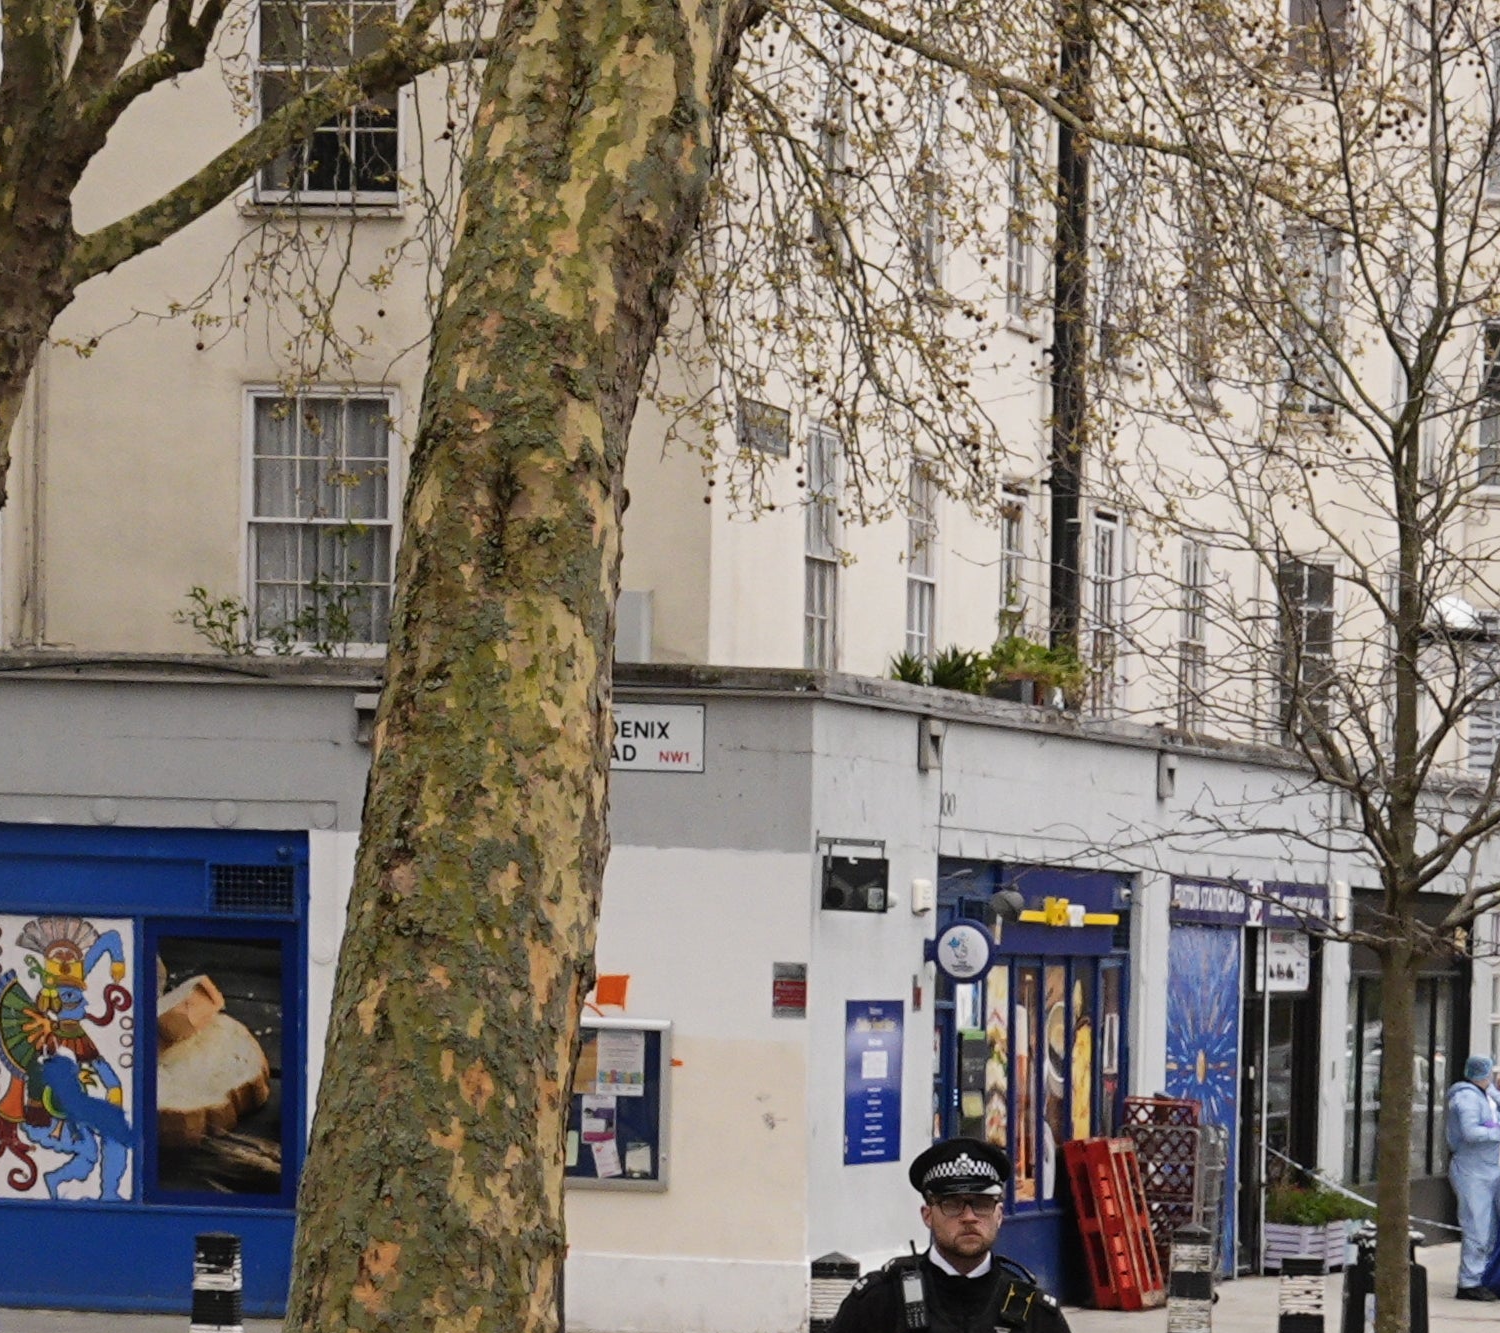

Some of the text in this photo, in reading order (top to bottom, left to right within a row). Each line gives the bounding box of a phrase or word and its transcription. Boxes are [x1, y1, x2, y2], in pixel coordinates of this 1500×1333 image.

[614, 720, 670, 740] ENIX
[610, 744, 690, 763] AD NW1
